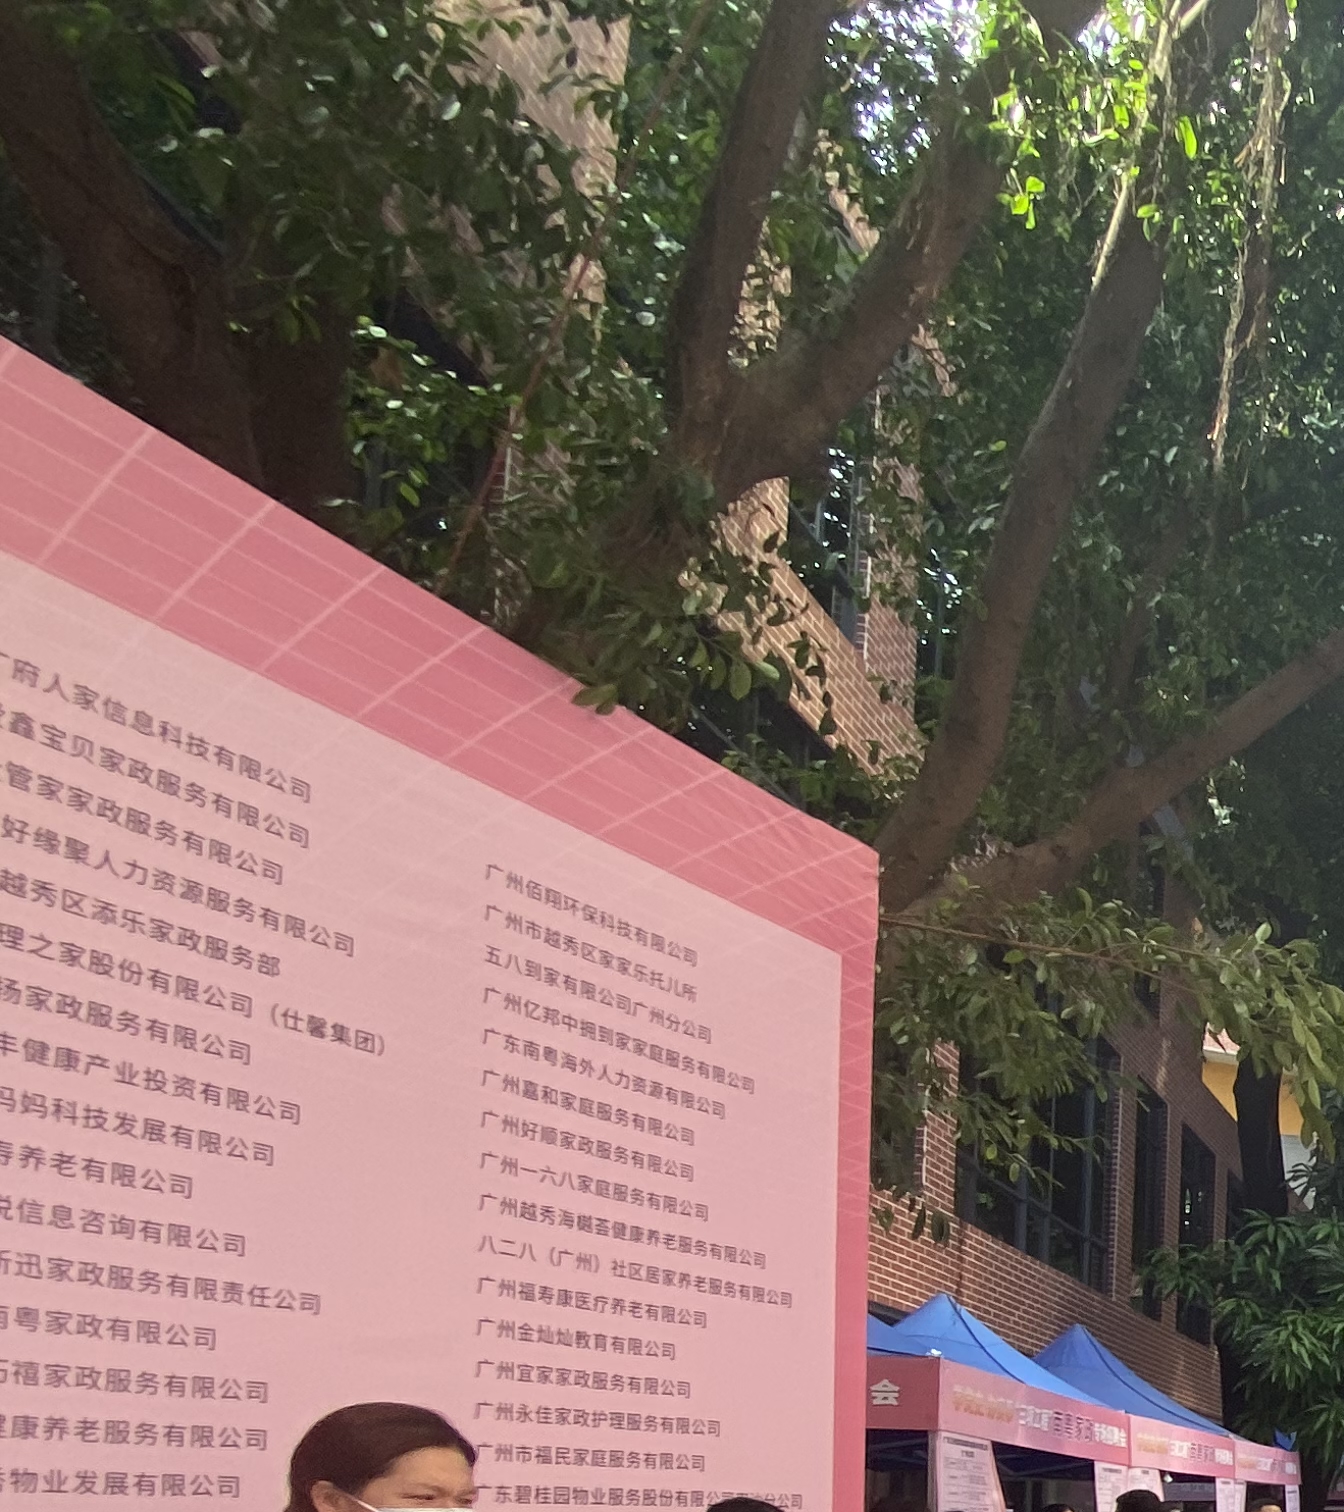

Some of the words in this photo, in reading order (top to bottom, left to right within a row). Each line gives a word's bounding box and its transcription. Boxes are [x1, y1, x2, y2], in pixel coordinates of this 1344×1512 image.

[0, 652, 312, 803] 府人家信息科技有限公司
[0, 703, 310, 849] 鑫宝贝家政服务有限公司
[0, 761, 284, 885] 管家家政服务有限公司
[0, 867, 282, 978] 越秀区添乐家政服务部
[1, 814, 355, 957] 好缘聚人力资源服务有限公司
[484, 944, 712, 1045] 五八到家有限公司广州分公司
[479, 1151, 709, 1223] 广州一六八家庭服务有限公司
[0, 1467, 241, 1498] 物业发展有限公司
